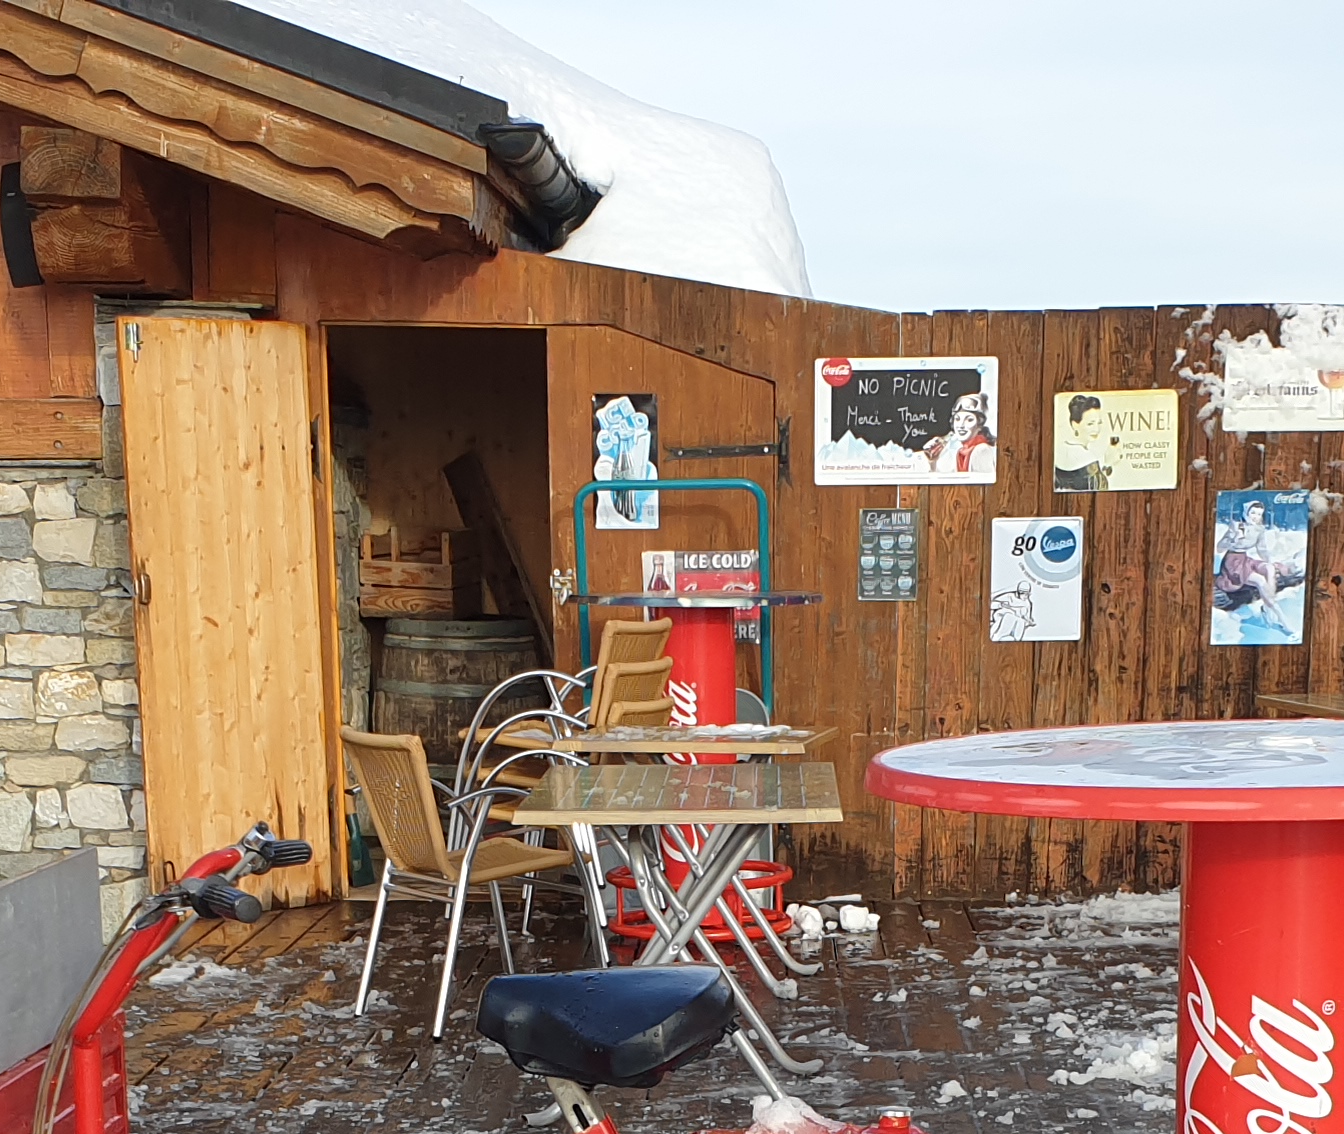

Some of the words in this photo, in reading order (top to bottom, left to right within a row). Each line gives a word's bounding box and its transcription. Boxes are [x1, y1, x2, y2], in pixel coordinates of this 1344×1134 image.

[859, 378, 880, 396] NO
[846, 404, 882, 427] Merci
[897, 406, 937, 424] Thank
[1107, 411, 1171, 432] WINE!
[901, 423, 928, 443] You
[1011, 534, 1037, 556] go
[1043, 536, 1075, 553] Vespa
[684, 553, 709, 569] ICE
[711, 553, 751, 569] COLD
